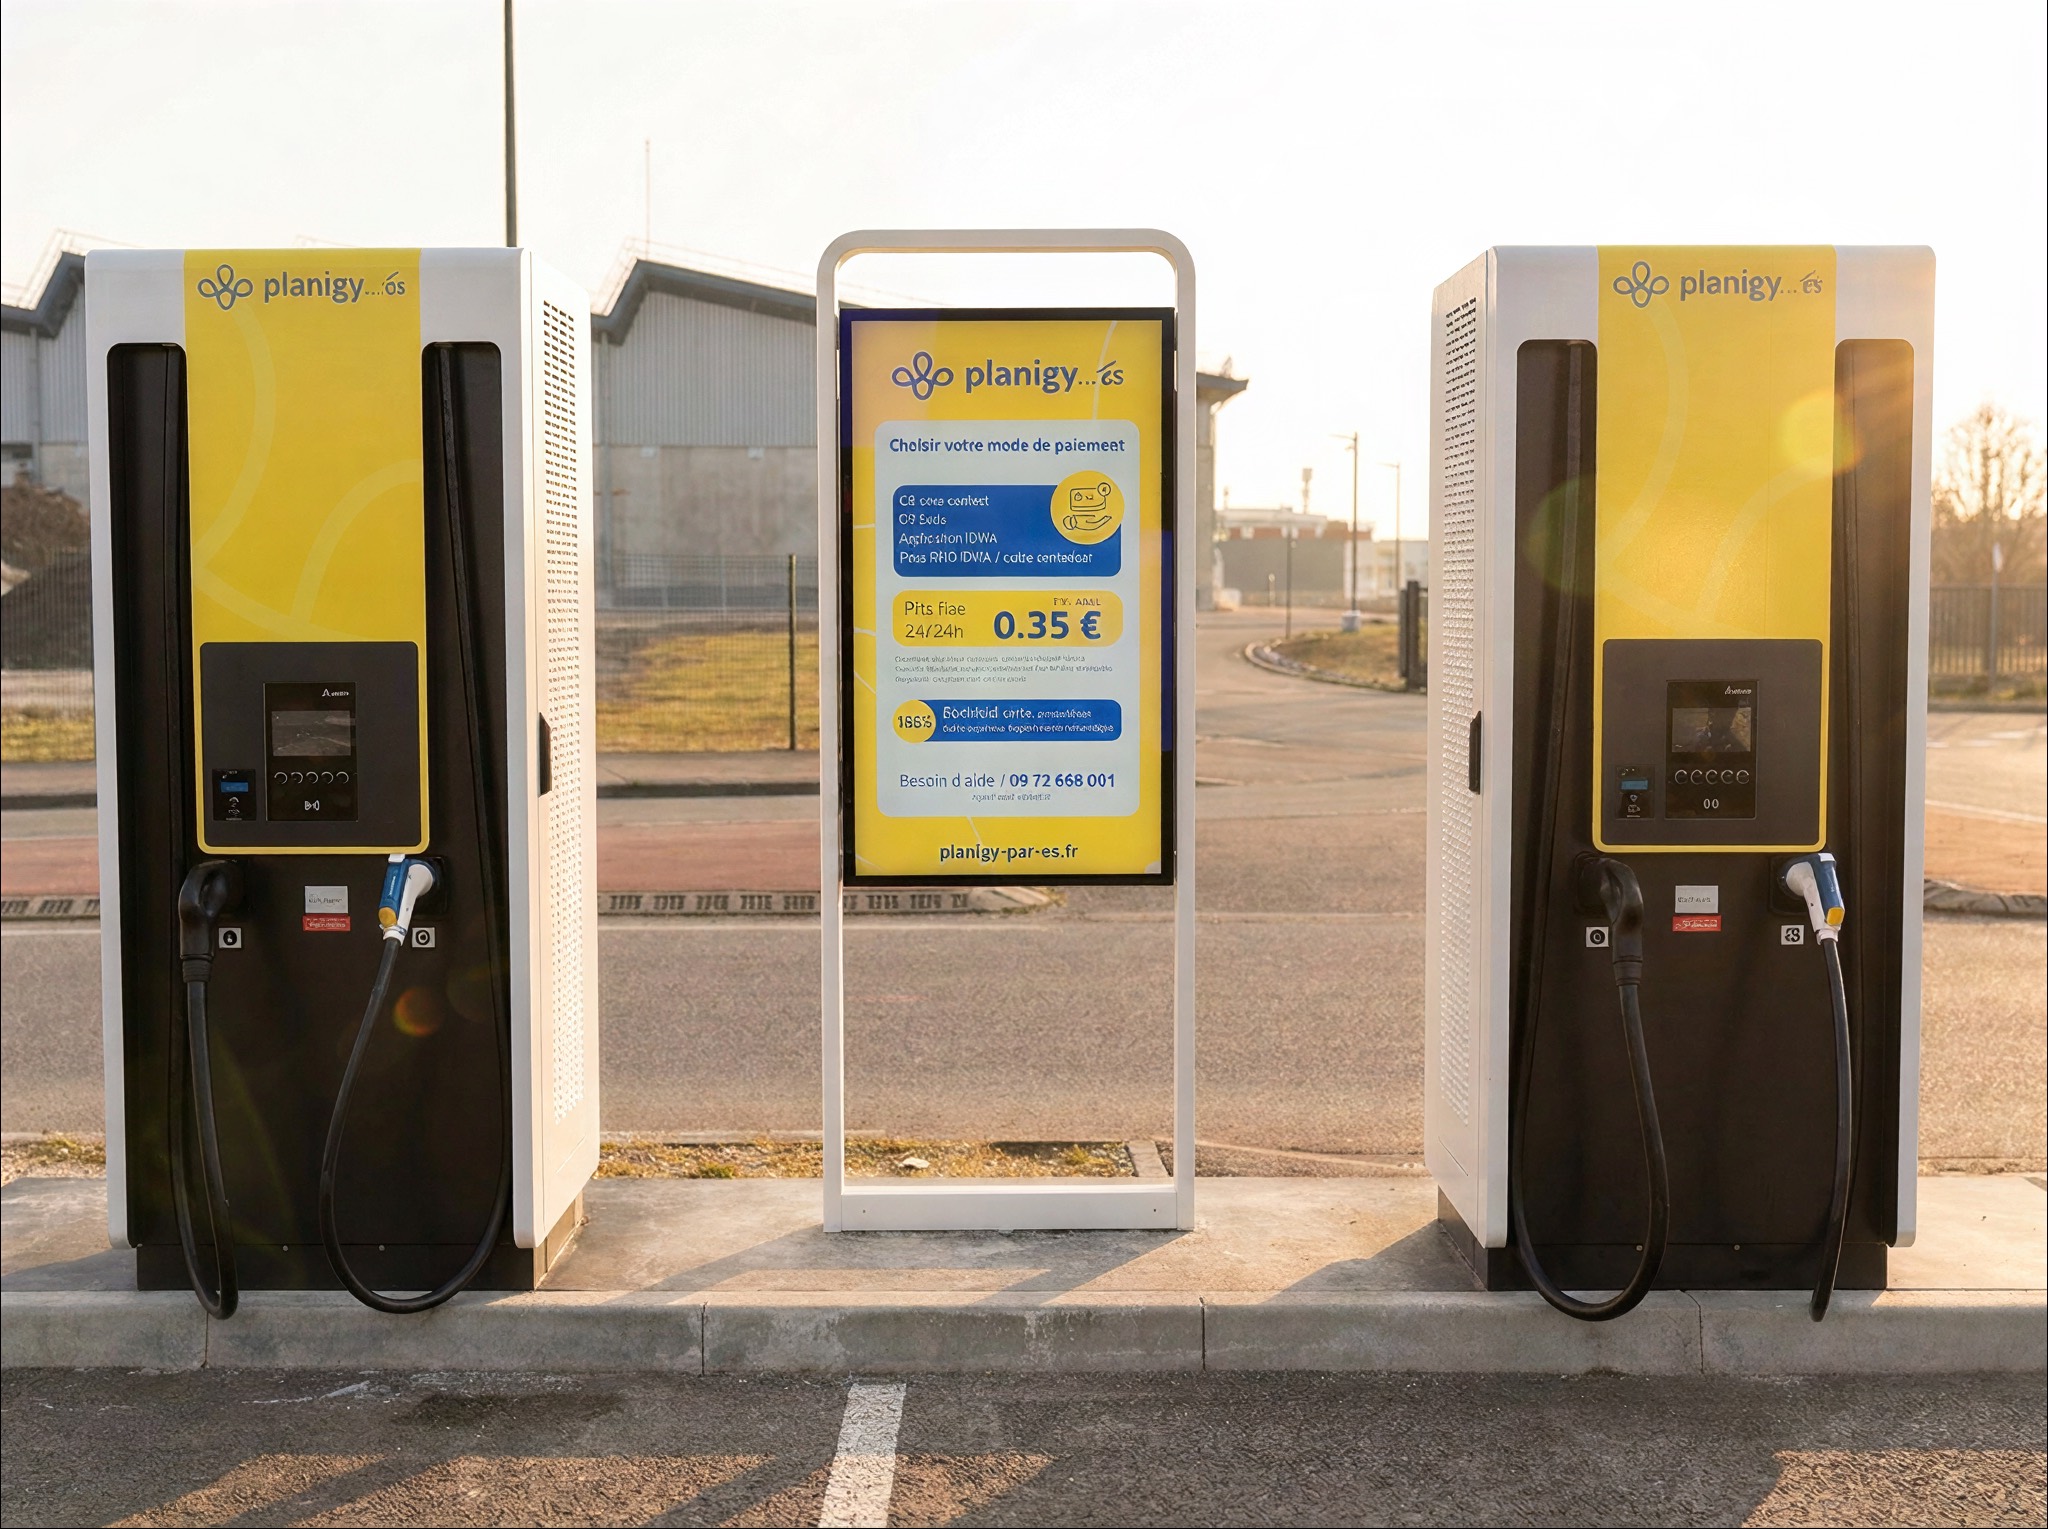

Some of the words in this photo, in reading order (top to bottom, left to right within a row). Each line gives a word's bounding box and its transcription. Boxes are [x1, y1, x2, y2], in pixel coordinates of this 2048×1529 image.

[944, 439, 984, 452] votre
[987, 437, 1029, 452] mode
[1032, 437, 1051, 452] de
[993, 610, 1070, 640] 0.35
[1079, 610, 1102, 640] €
[900, 773, 947, 788] Besoin
[1009, 773, 1029, 788] 09
[1032, 773, 1052, 788] 72
[1054, 773, 1084, 788] 668
[1086, 773, 1115, 788] 001
[940, 844, 1079, 864] planigy-par-es.fr
